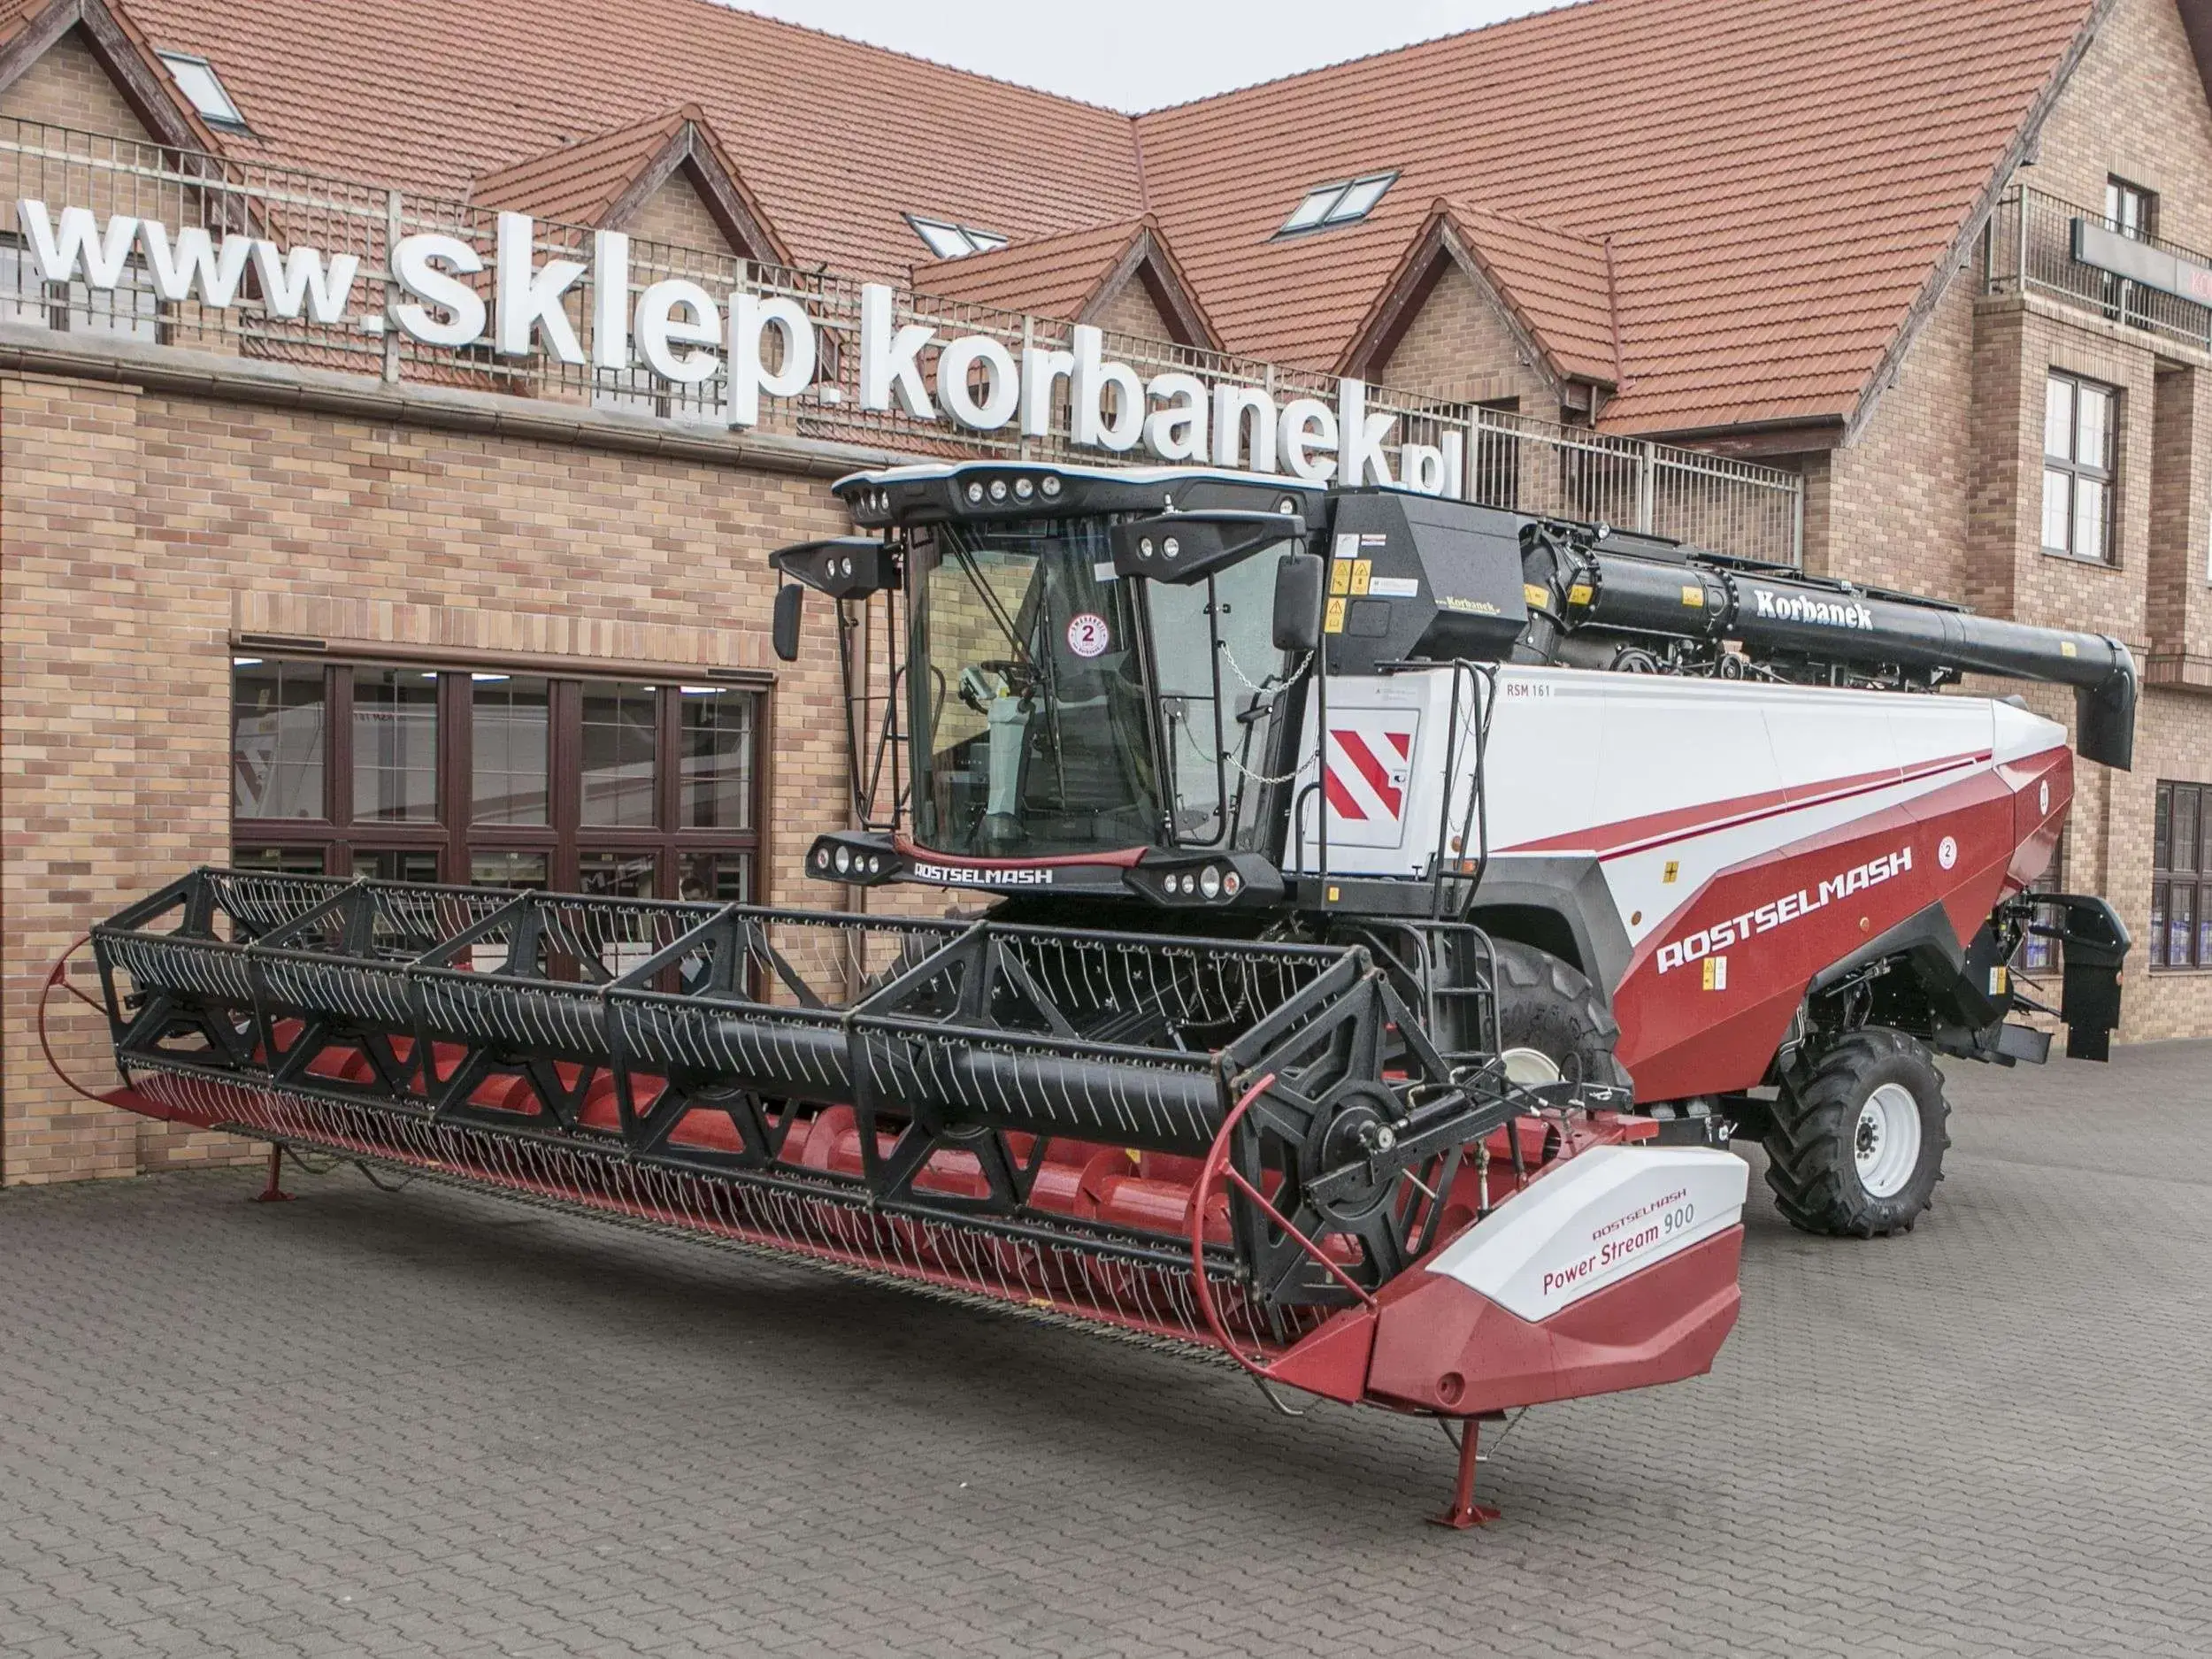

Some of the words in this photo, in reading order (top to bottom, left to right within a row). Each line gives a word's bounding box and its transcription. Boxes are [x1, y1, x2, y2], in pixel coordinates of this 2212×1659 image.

[1755, 589, 1873, 630] Korbanek
[1082, 625, 1094, 641] 2
[1507, 684, 1529, 696] RSM
[1533, 685, 1550, 697] 161
[1945, 844, 1952, 857] 2
[914, 862, 1053, 884] ROSTSELMASH
[1655, 847, 1913, 974] ROSTSELMASH
[1592, 1187, 1687, 1241] ROSTSELMASH
[1543, 1256, 1596, 1295] Power
[1601, 1225, 1659, 1268] Stream
[1663, 1202, 1694, 1234] 900
